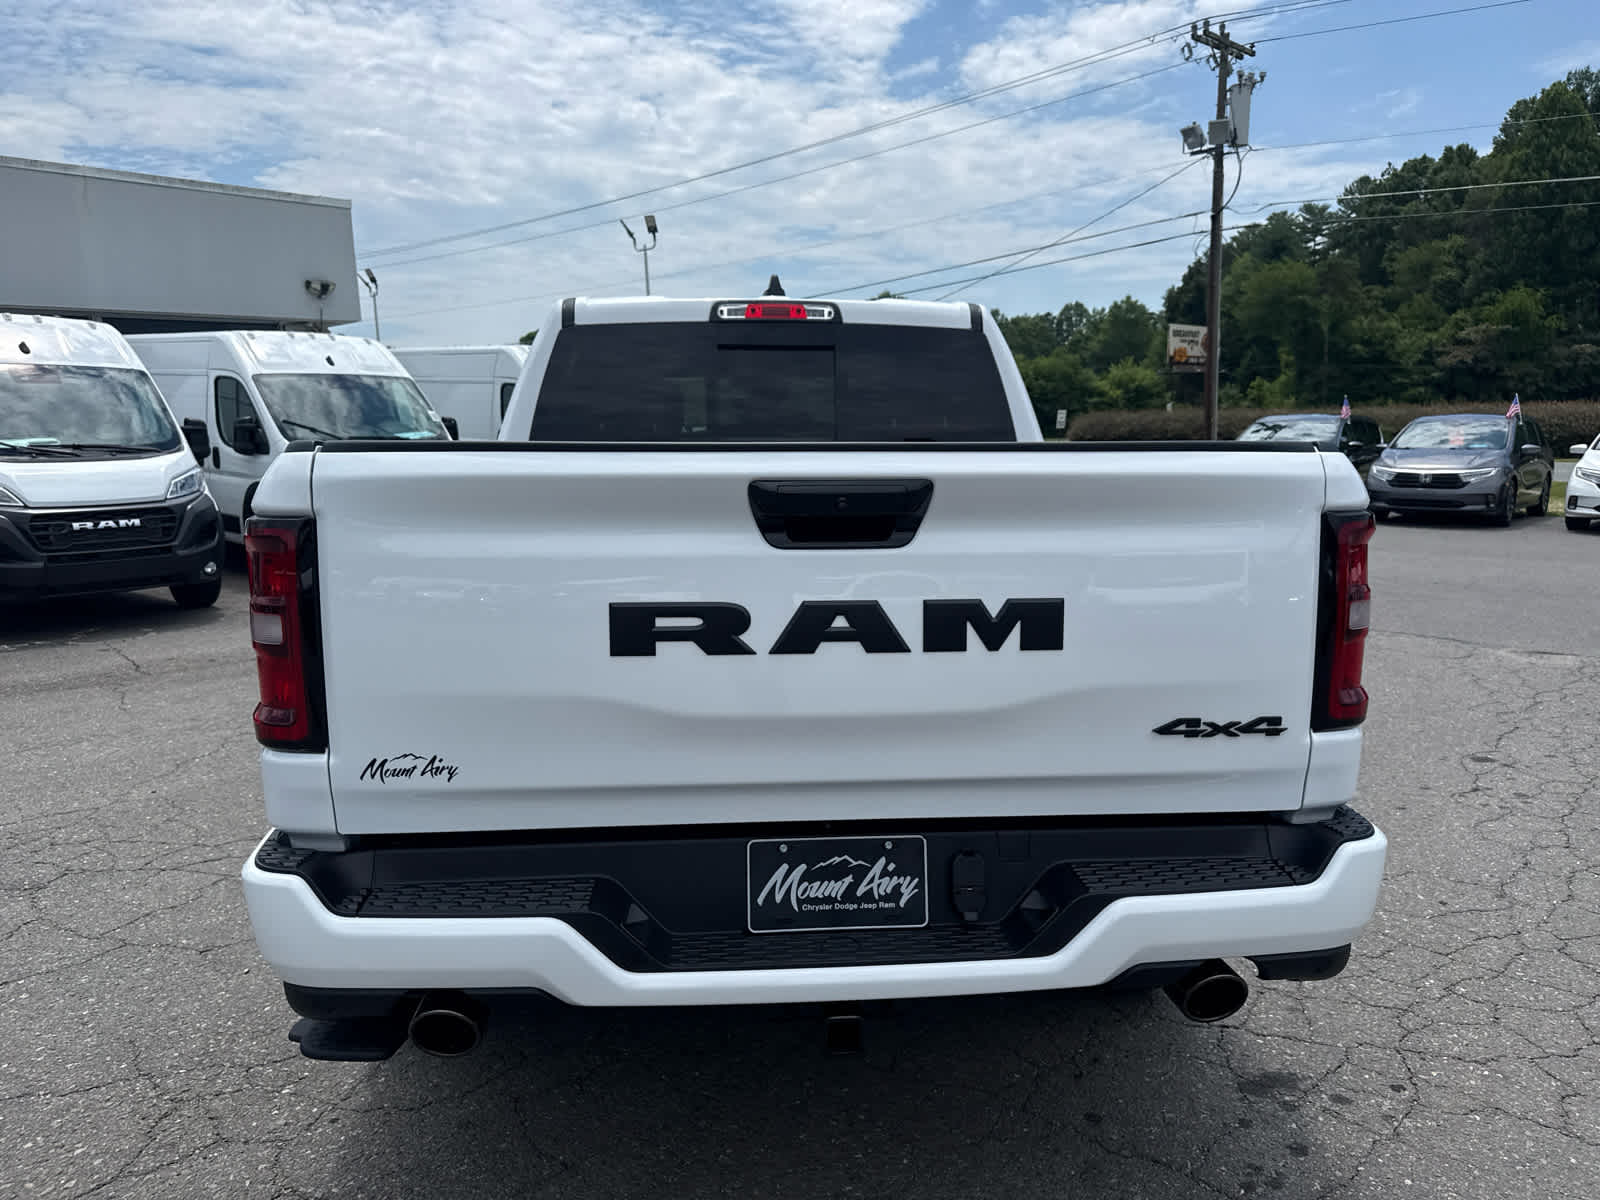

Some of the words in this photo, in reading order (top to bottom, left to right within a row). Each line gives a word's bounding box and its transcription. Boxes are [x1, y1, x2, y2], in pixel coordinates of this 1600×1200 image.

[72, 518, 141, 531] RAM
[609, 597, 1065, 657] RAM
[1151, 716, 1288, 738] 4x4
[359, 758, 418, 784] Mount
[420, 754, 459, 783] Airy
[757, 862, 854, 913] Mount
[855, 855, 919, 908] Airy
[801, 903, 833, 912] Chrysler
[834, 902, 858, 911] Dodge
[859, 902, 878, 910] Jeep
[878, 901, 896, 909] Ram
